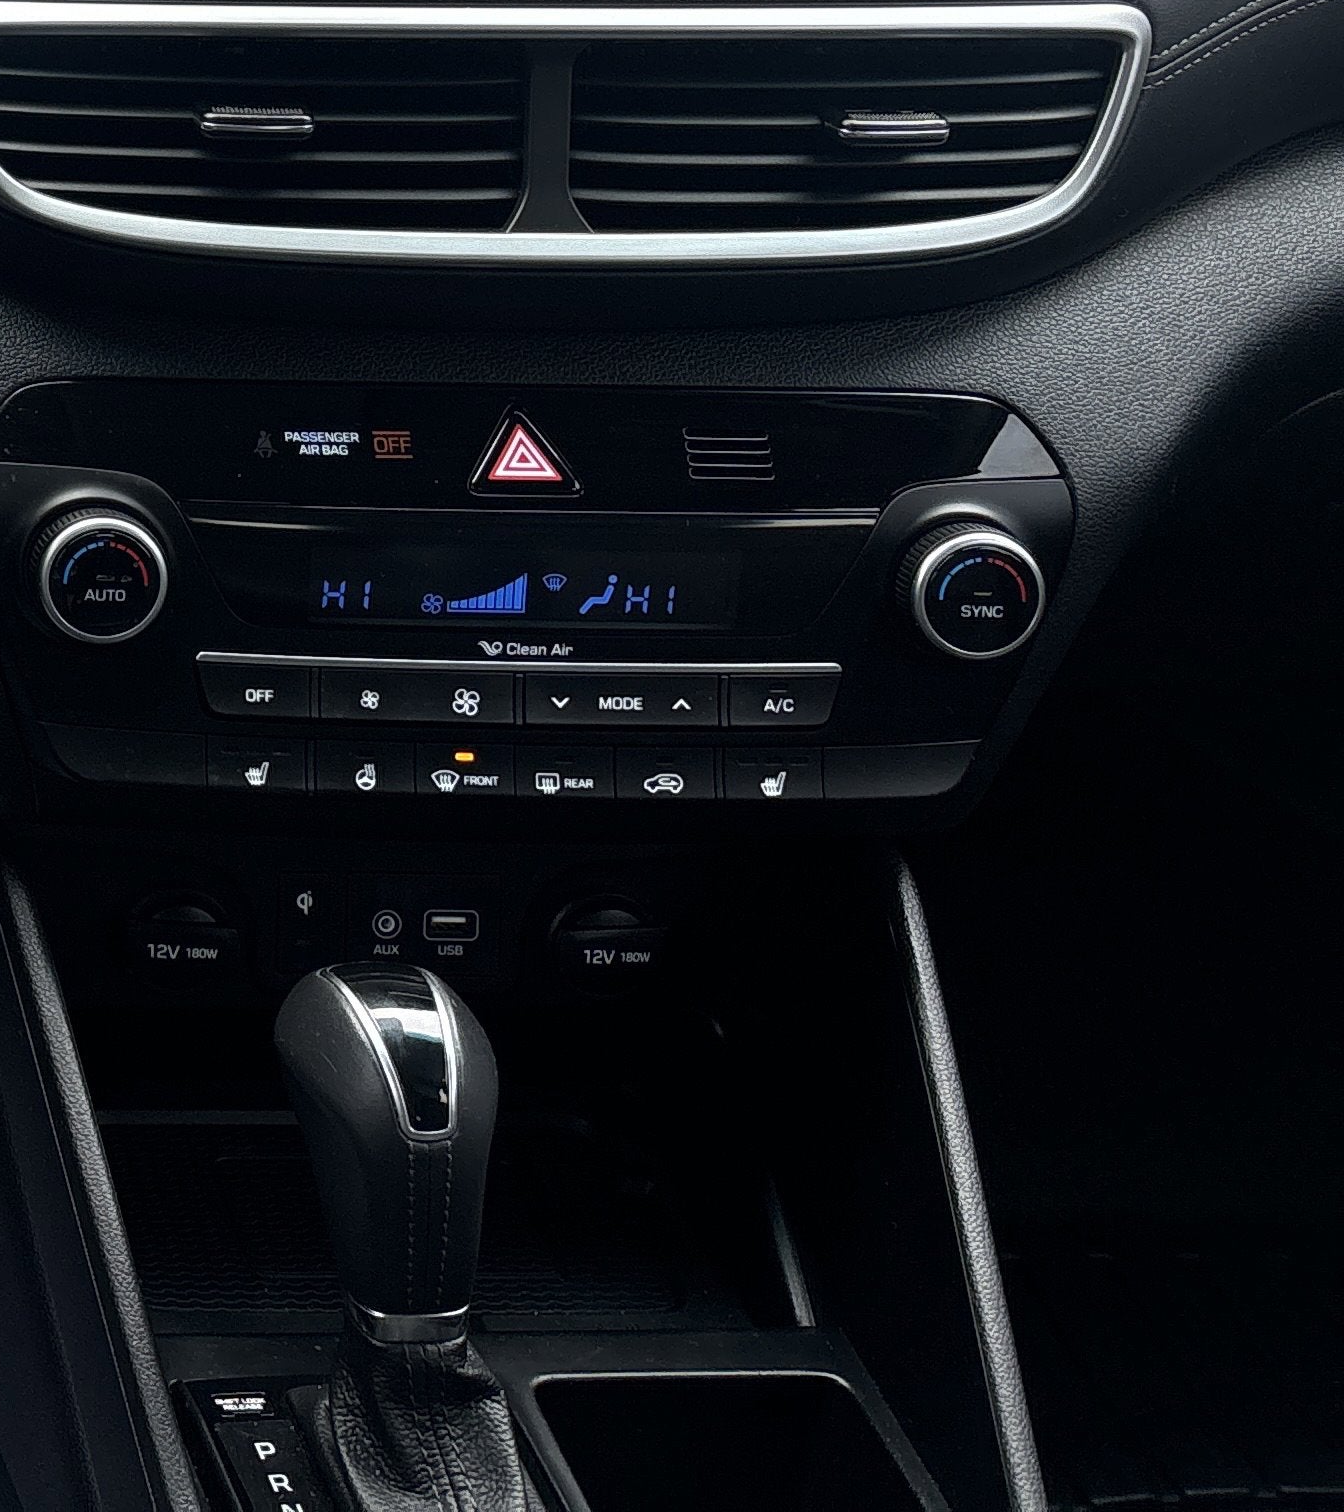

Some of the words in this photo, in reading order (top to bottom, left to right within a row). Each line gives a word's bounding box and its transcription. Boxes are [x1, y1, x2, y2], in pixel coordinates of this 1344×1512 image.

[284, 431, 360, 443] PASSENGER
[299, 444, 320, 455] AIR
[322, 445, 348, 456] BAG
[373, 437, 411, 454] OFF
[84, 589, 126, 602] AUTO
[960, 604, 1004, 618] SYNC
[506, 642, 547, 656] Clean
[551, 643, 574, 656] Air
[245, 688, 274, 702] OFF
[599, 697, 644, 711] MODE
[763, 698, 794, 713] A/C
[464, 775, 499, 787] FRONT
[564, 778, 594, 789] REAR
[147, 944, 181, 959] 12V
[185, 947, 218, 959] 180W
[373, 945, 399, 956] AUX
[438, 945, 463, 956] USB
[583, 950, 615, 965] 12V
[620, 952, 651, 963] 180W
[254, 1442, 276, 1460] P
[267, 1474, 294, 1493] R
